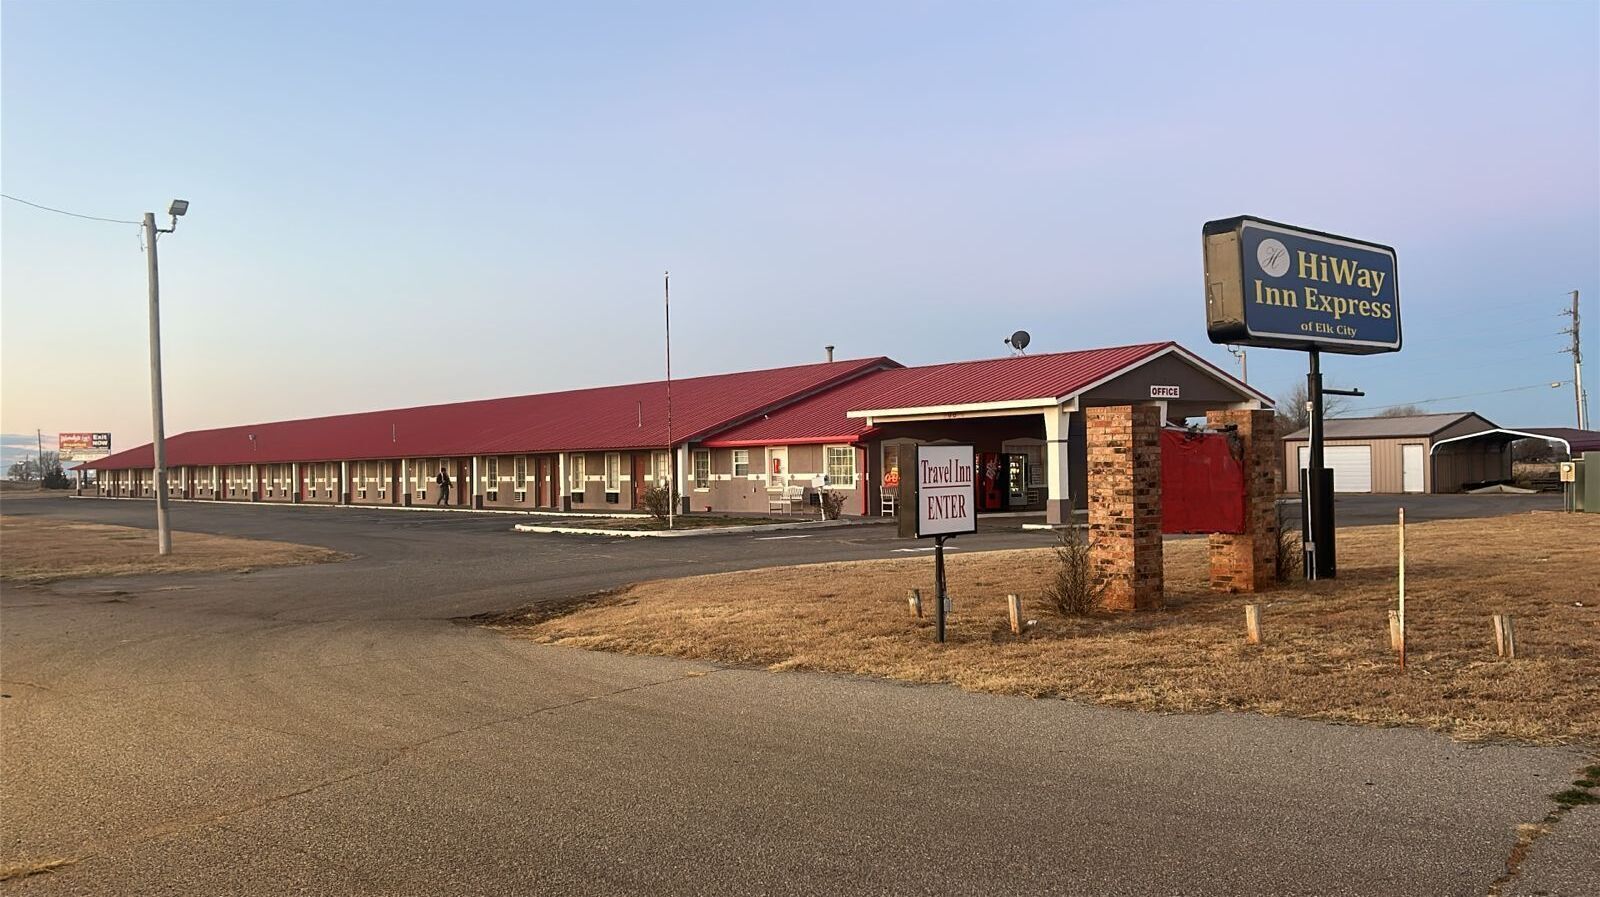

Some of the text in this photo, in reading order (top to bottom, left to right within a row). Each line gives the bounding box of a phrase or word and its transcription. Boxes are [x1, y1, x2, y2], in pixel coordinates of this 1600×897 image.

[1297, 250, 1385, 296] HiWay
[1254, 280, 1391, 319] Inn Express
[1301, 321, 1357, 337] of Elk City
[1152, 387, 1178, 396] OFFICE
[921, 459, 952, 484] Travel
[955, 458, 971, 482] Inn
[927, 495, 966, 520] ENTER
